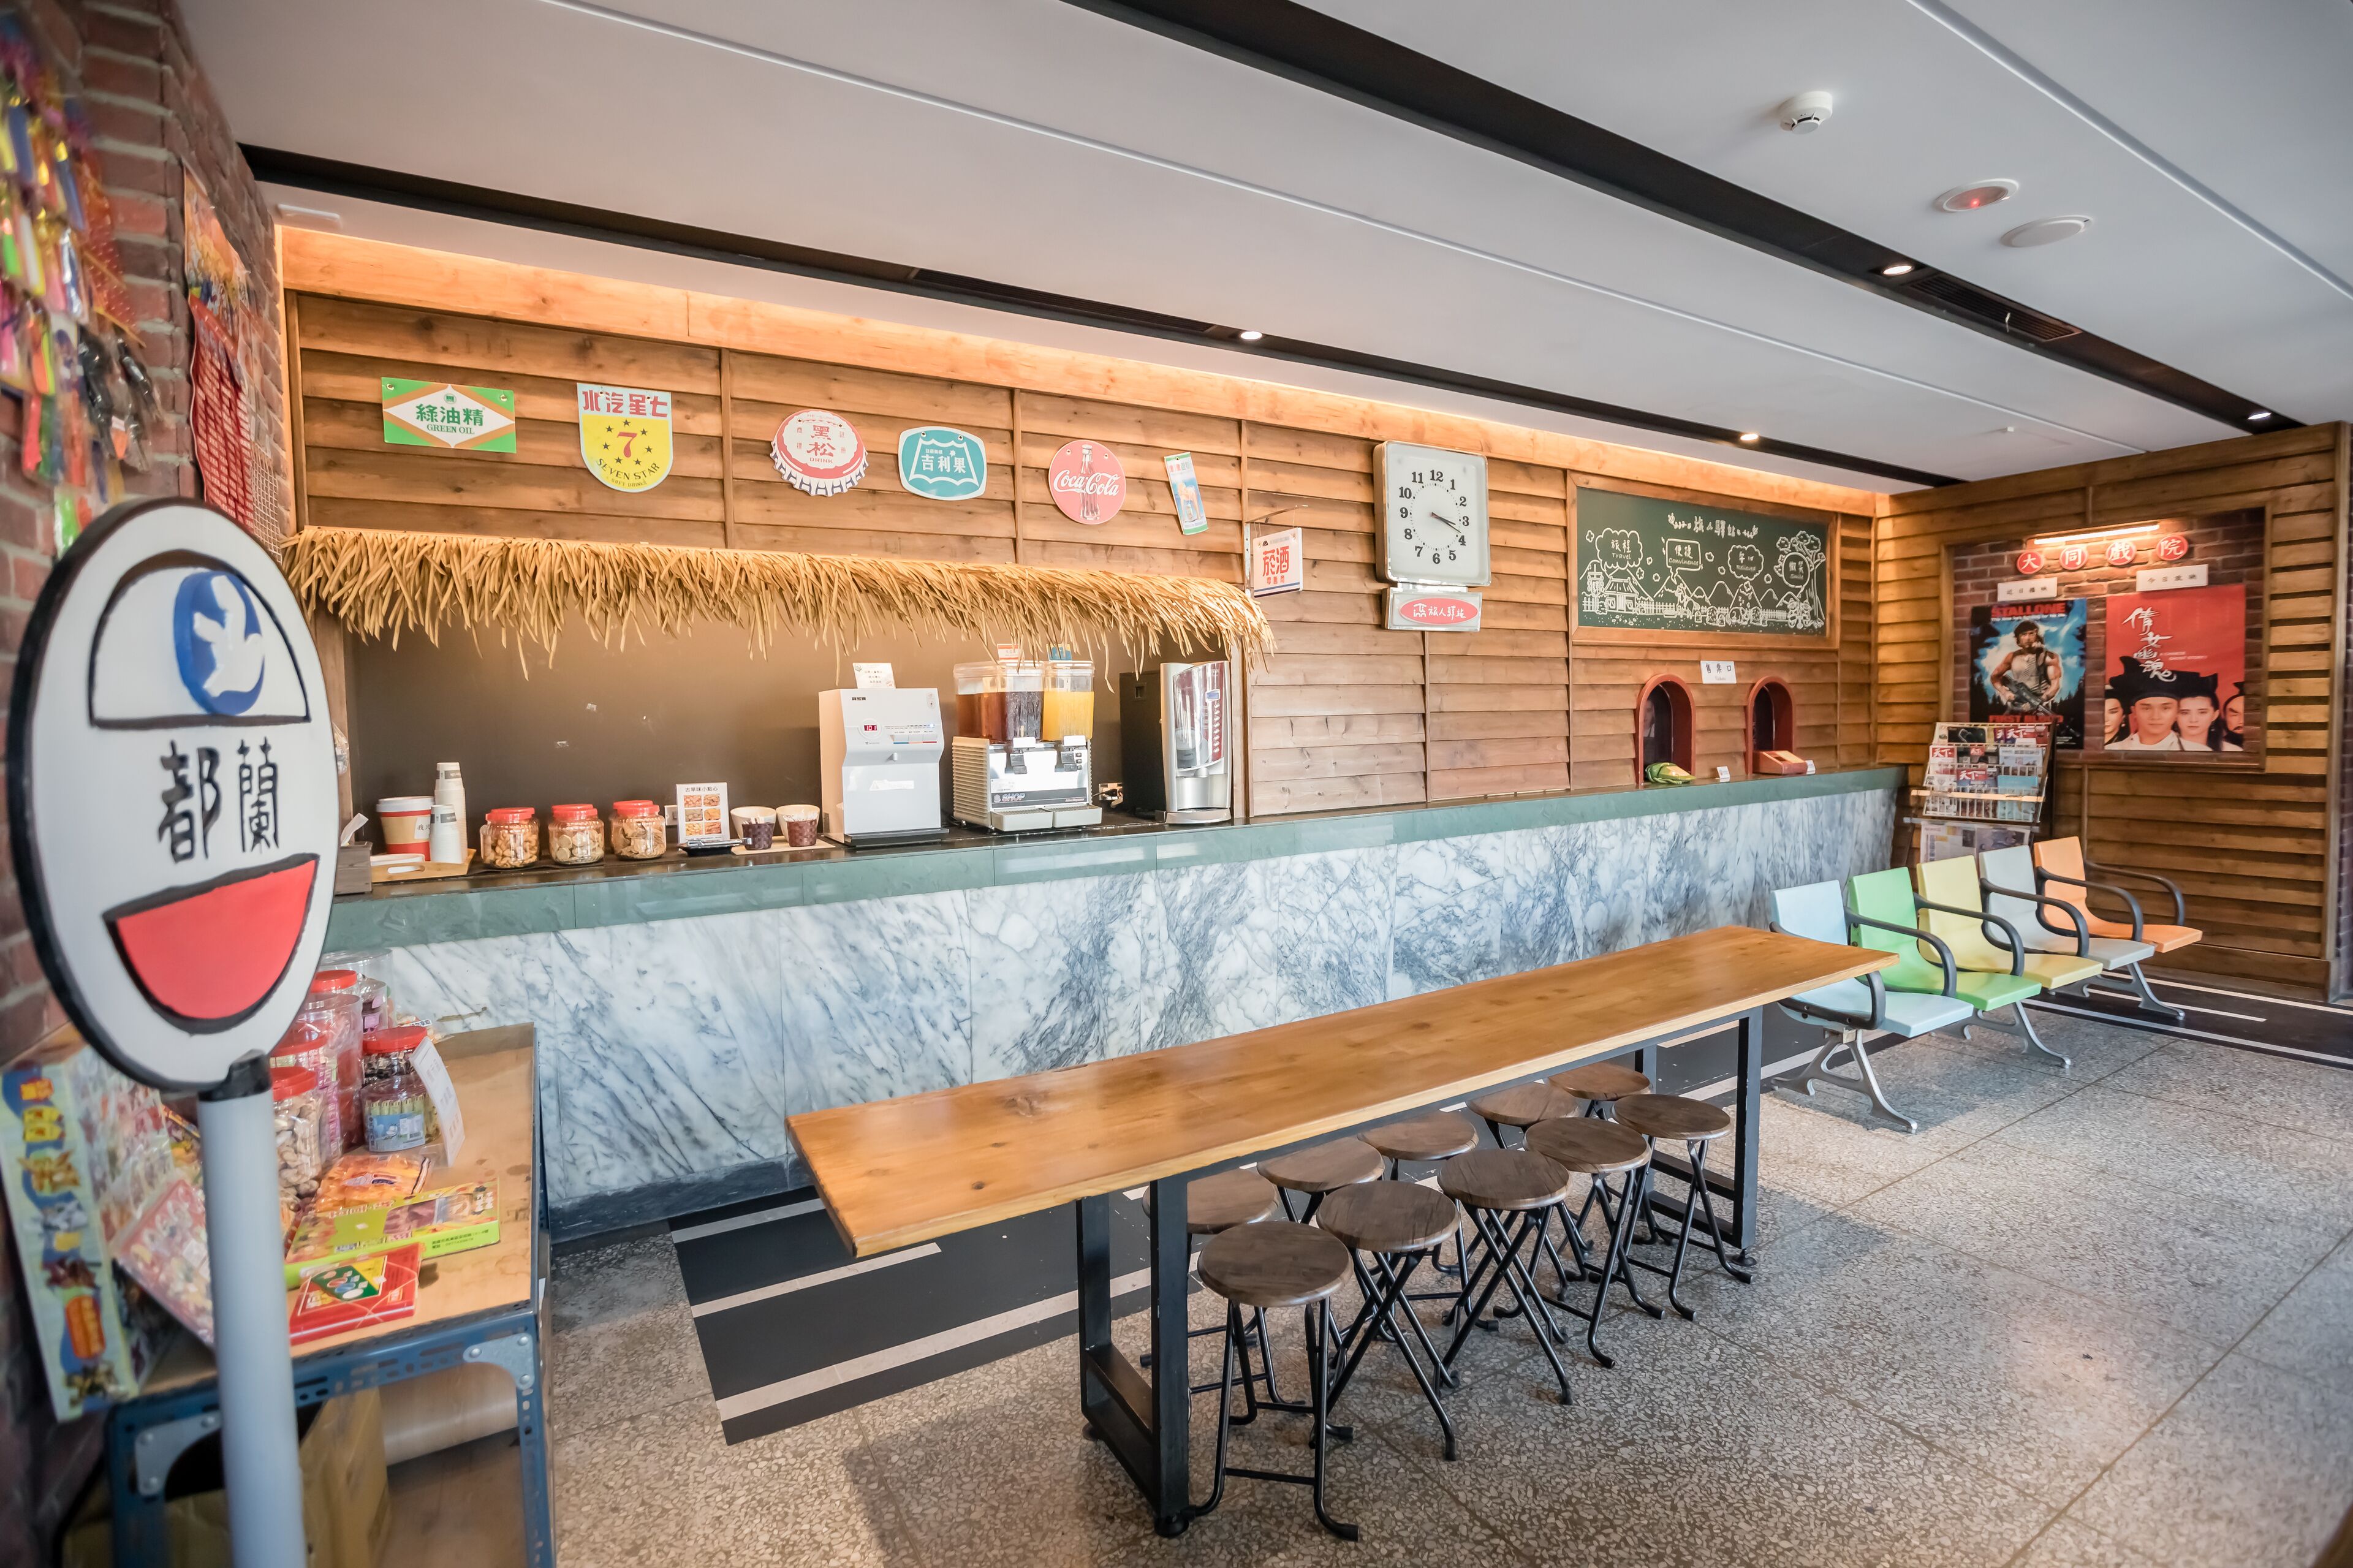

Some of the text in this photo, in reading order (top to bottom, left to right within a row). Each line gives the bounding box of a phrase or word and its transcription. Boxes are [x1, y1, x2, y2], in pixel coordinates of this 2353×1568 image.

[415, 403, 484, 426] 綠油精
[426, 424, 457, 434] GREEN
[617, 431, 638, 458] 7
[806, 425, 836, 457] 黑松
[597, 458, 660, 480] SEVEN STAR
[921, 454, 966, 474] 吉利果
[1411, 471, 1423, 484] 11
[1430, 470, 1444, 482] 12
[1450, 479, 1456, 490] 1
[1399, 487, 1412, 498] 10
[1460, 496, 1468, 507] 2
[1400, 507, 1409, 518] 9
[1462, 516, 1469, 526] 3
[1404, 528, 1412, 540] 8
[1458, 535, 1466, 546] 4
[1414, 545, 1423, 557] 7
[1449, 550, 1457, 561] 5
[1262, 545, 1289, 577] 菸酒
[1432, 553, 1441, 564] 6
[1991, 602, 2066, 618] STALLONE
[1705, 662, 1732, 674] 售票口
[1932, 746, 1952, 758] 天下
[1959, 770, 1987, 781] 天下
[158, 737, 279, 864] 都蘭
[1001, 792, 1026, 803] SHOP
